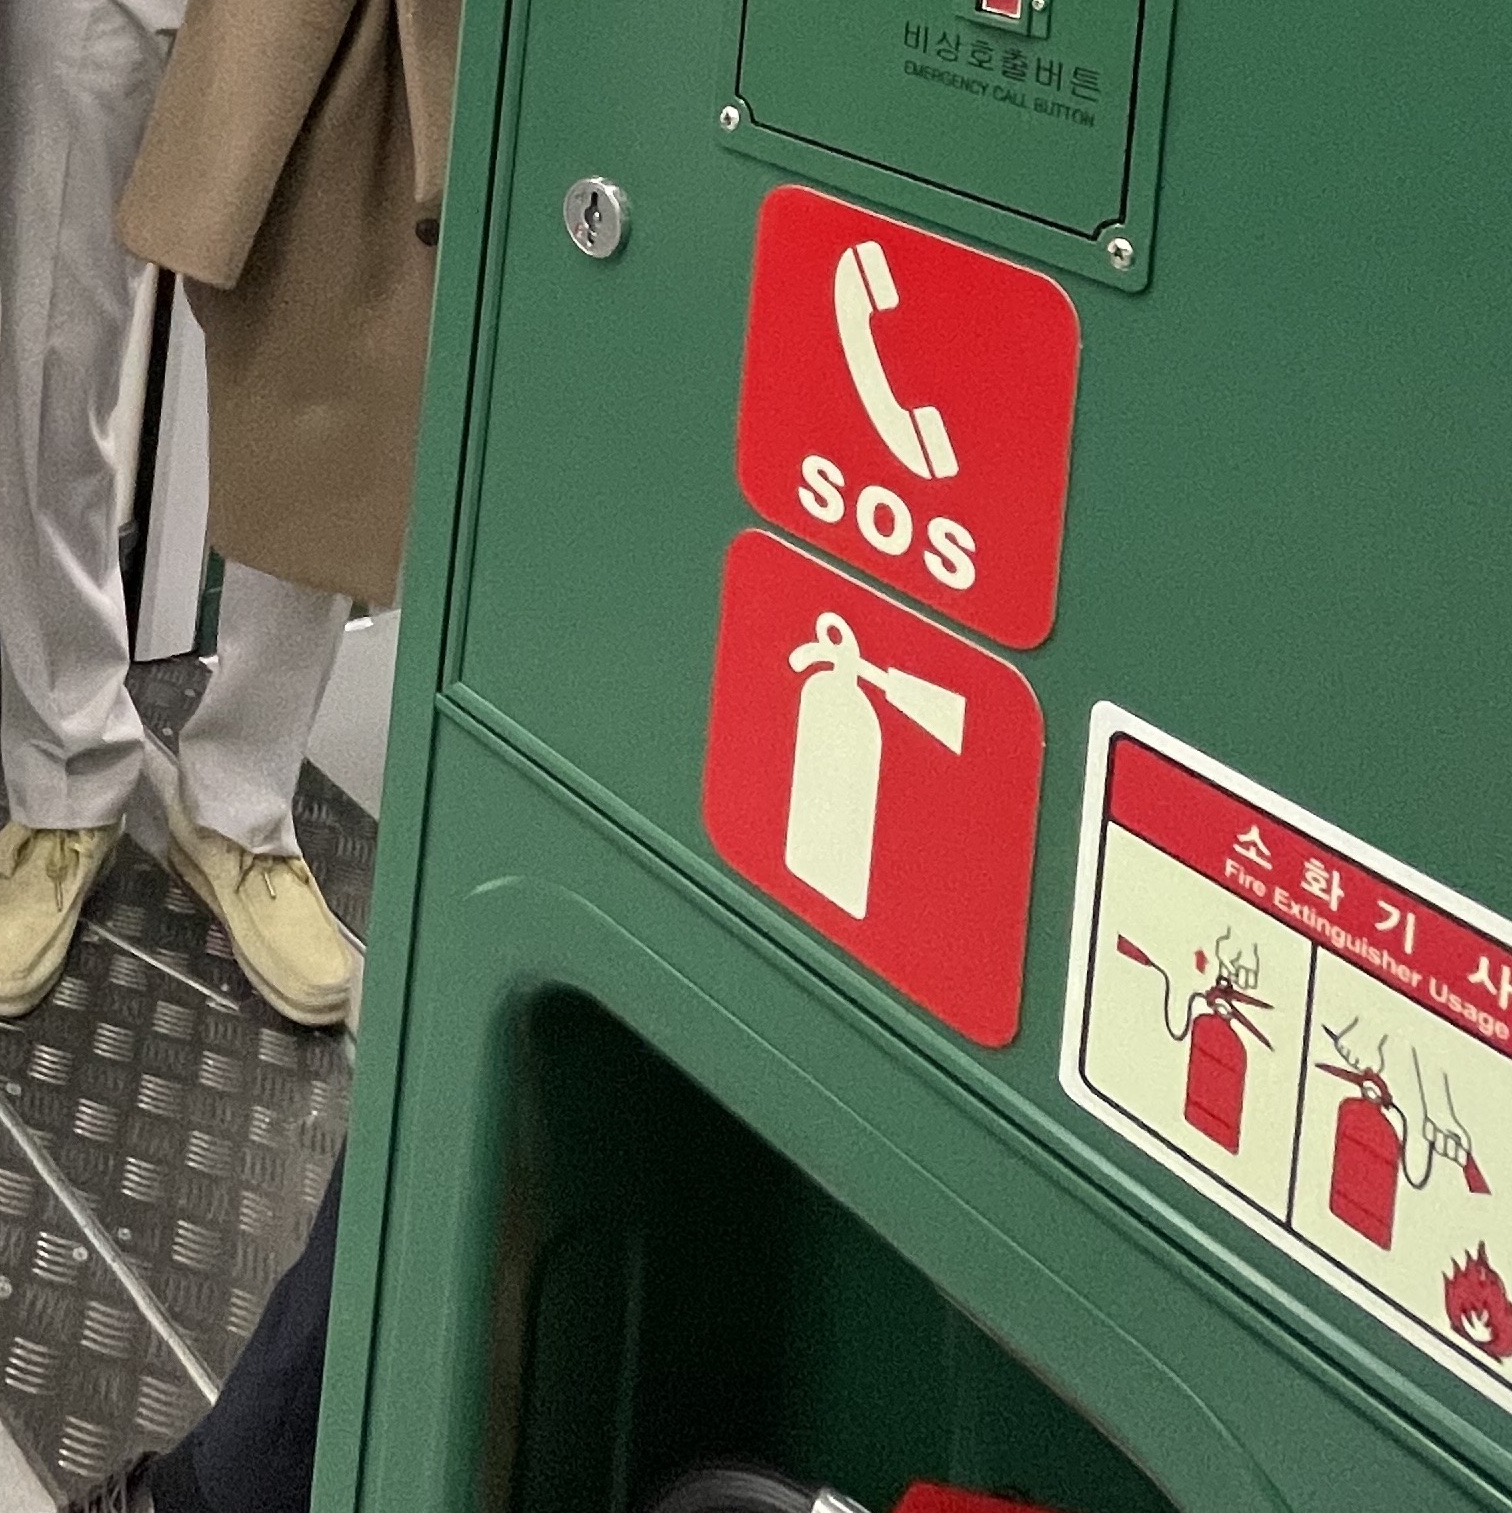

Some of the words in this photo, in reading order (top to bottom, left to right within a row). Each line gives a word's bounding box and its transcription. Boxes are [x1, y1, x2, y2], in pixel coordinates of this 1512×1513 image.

[903, 20, 1102, 103] 비상호출버튼
[904, 60, 988, 97] EMERGENCY
[992, 84, 1028, 109] CALL
[1033, 97, 1095, 128] BUTTON
[798, 454, 977, 592] SOS
[1225, 857, 1267, 898] Fire
[1273, 886, 1423, 988] Extinguisher
[1429, 976, 1511, 1040] Usage
